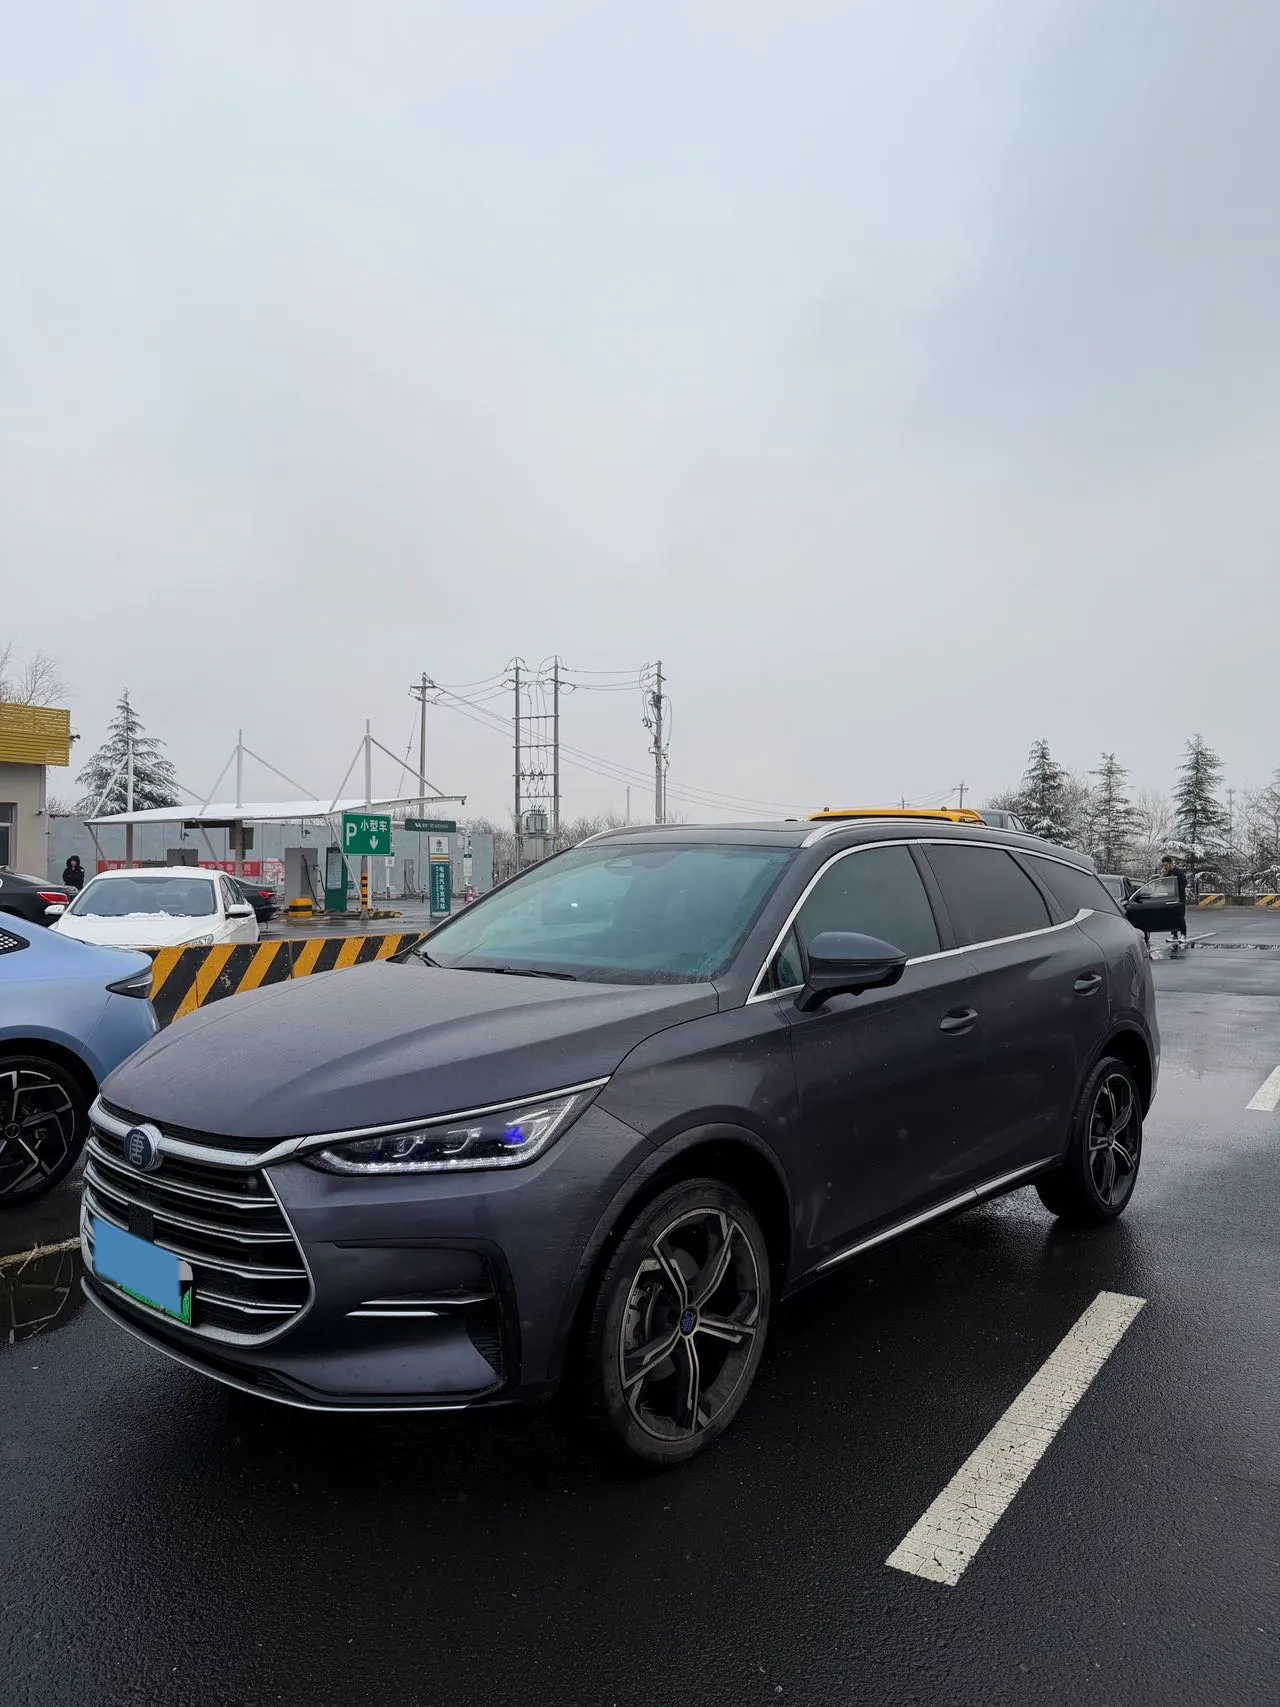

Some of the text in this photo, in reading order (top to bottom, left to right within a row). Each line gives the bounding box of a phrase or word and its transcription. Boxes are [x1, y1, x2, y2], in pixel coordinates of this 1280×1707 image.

[346, 822, 358, 846] P
[360, 819, 388, 832] 小型车
